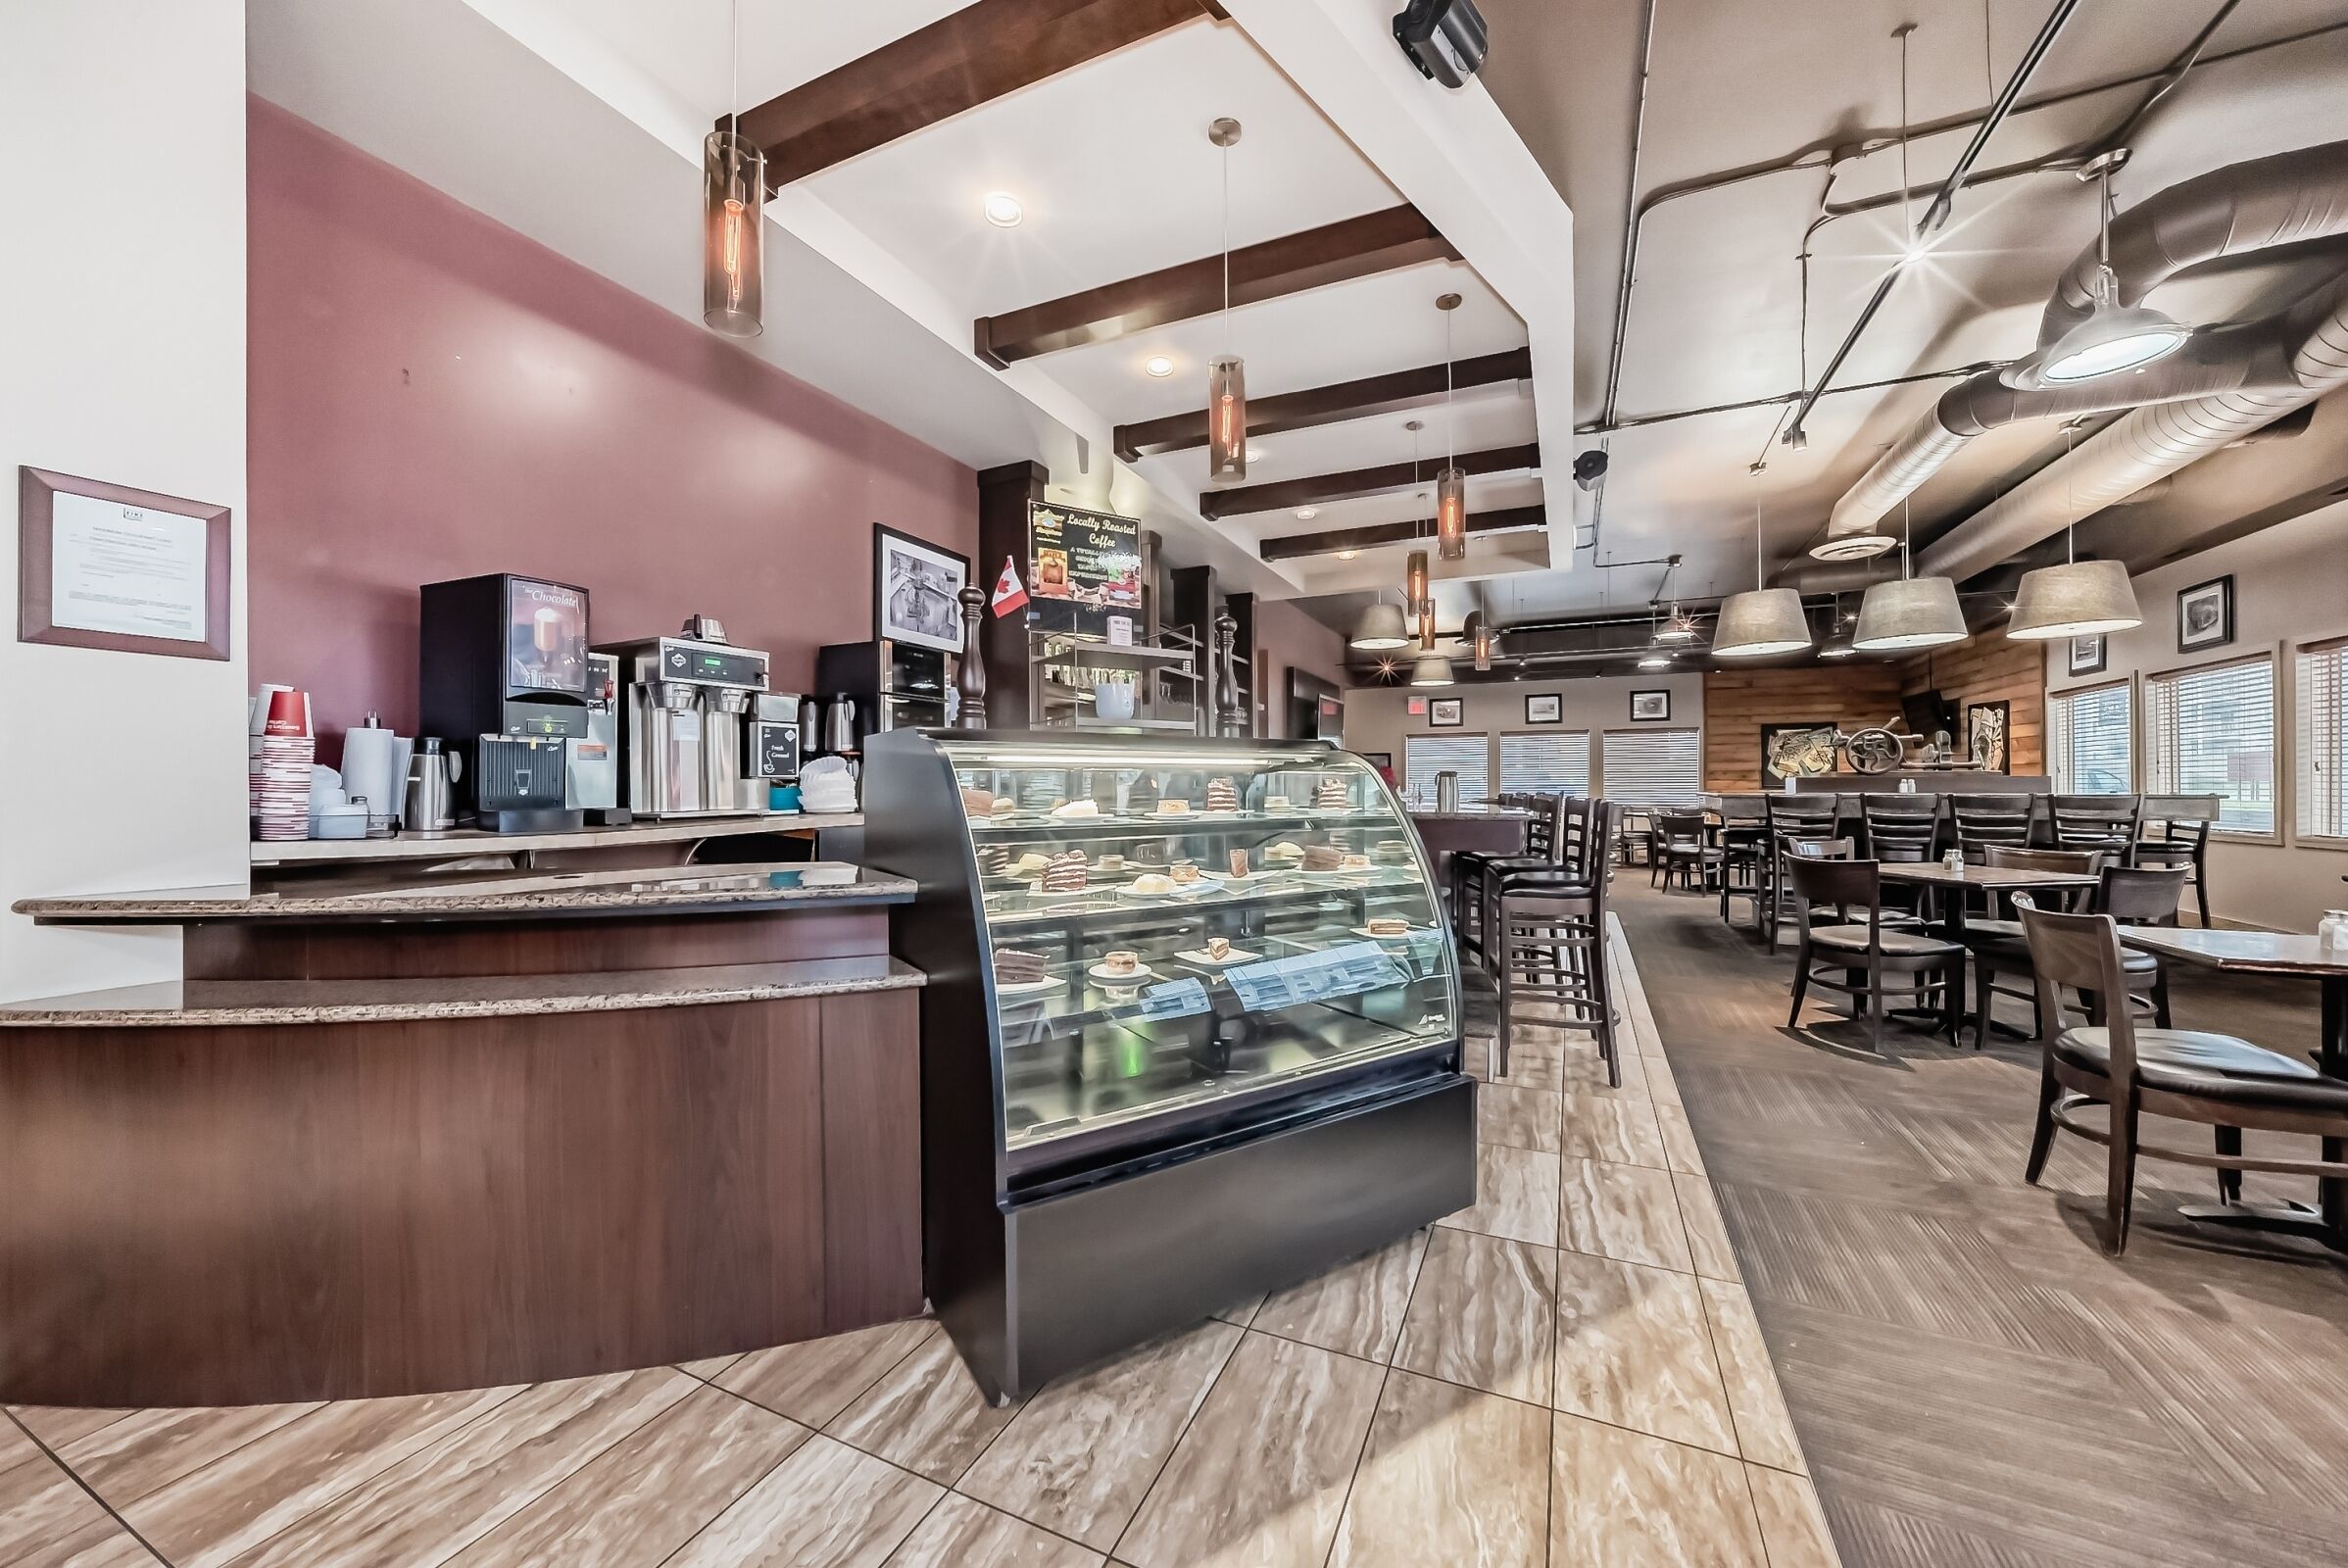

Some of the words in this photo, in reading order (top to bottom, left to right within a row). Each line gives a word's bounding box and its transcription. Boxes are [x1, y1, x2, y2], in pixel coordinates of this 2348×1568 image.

[1066, 514, 1101, 531] Locally
[1101, 519, 1136, 535] Roasted
[1089, 533, 1116, 549] Coffee
[532, 590, 577, 607] Chocolate
